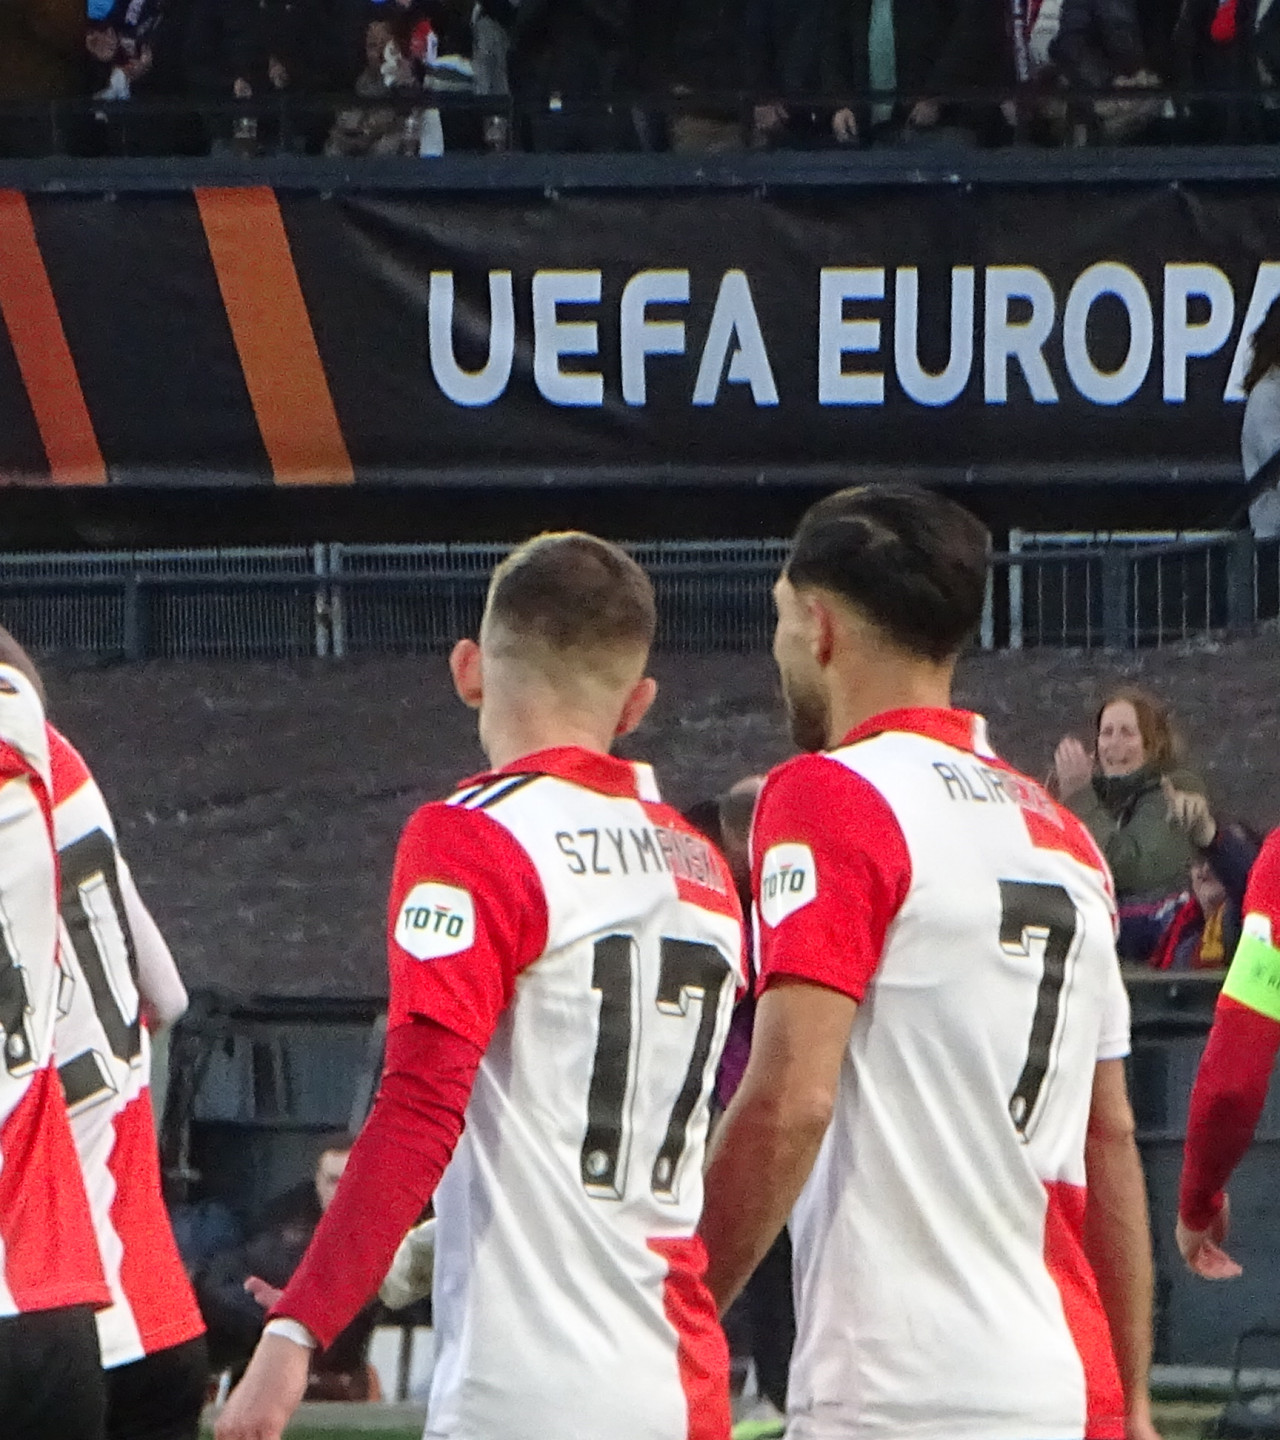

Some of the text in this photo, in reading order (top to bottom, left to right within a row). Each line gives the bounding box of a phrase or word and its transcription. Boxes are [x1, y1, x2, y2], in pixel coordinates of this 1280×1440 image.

[429, 269, 779, 406] UEFA
[404, 904, 464, 938] TOTO
[763, 866, 806, 901] TOTO
[581, 934, 732, 1204] 17
[997, 878, 1086, 1145] 7
